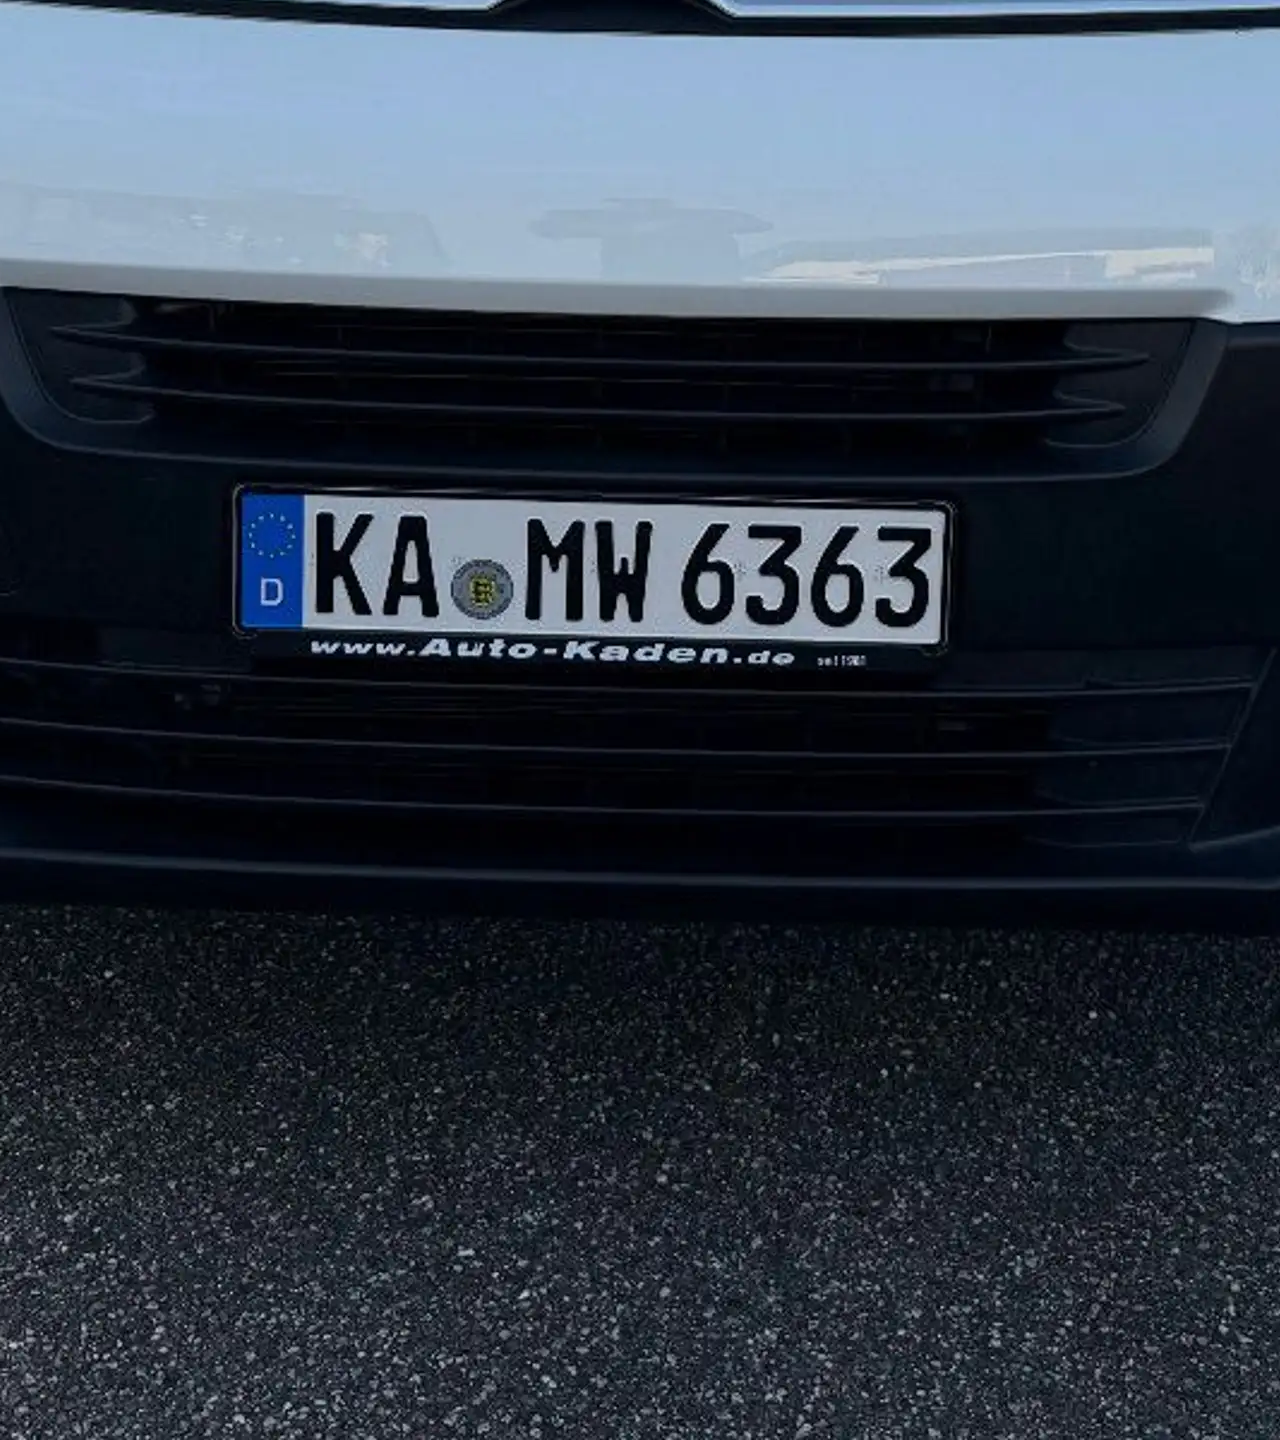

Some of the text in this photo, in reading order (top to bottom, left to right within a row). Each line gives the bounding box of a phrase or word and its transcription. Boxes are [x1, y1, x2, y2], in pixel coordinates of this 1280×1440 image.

[314, 513, 933, 628] KA MW 6363
[260, 578, 284, 607] D
[310, 637, 795, 665] www.Auto-Kaden.de
